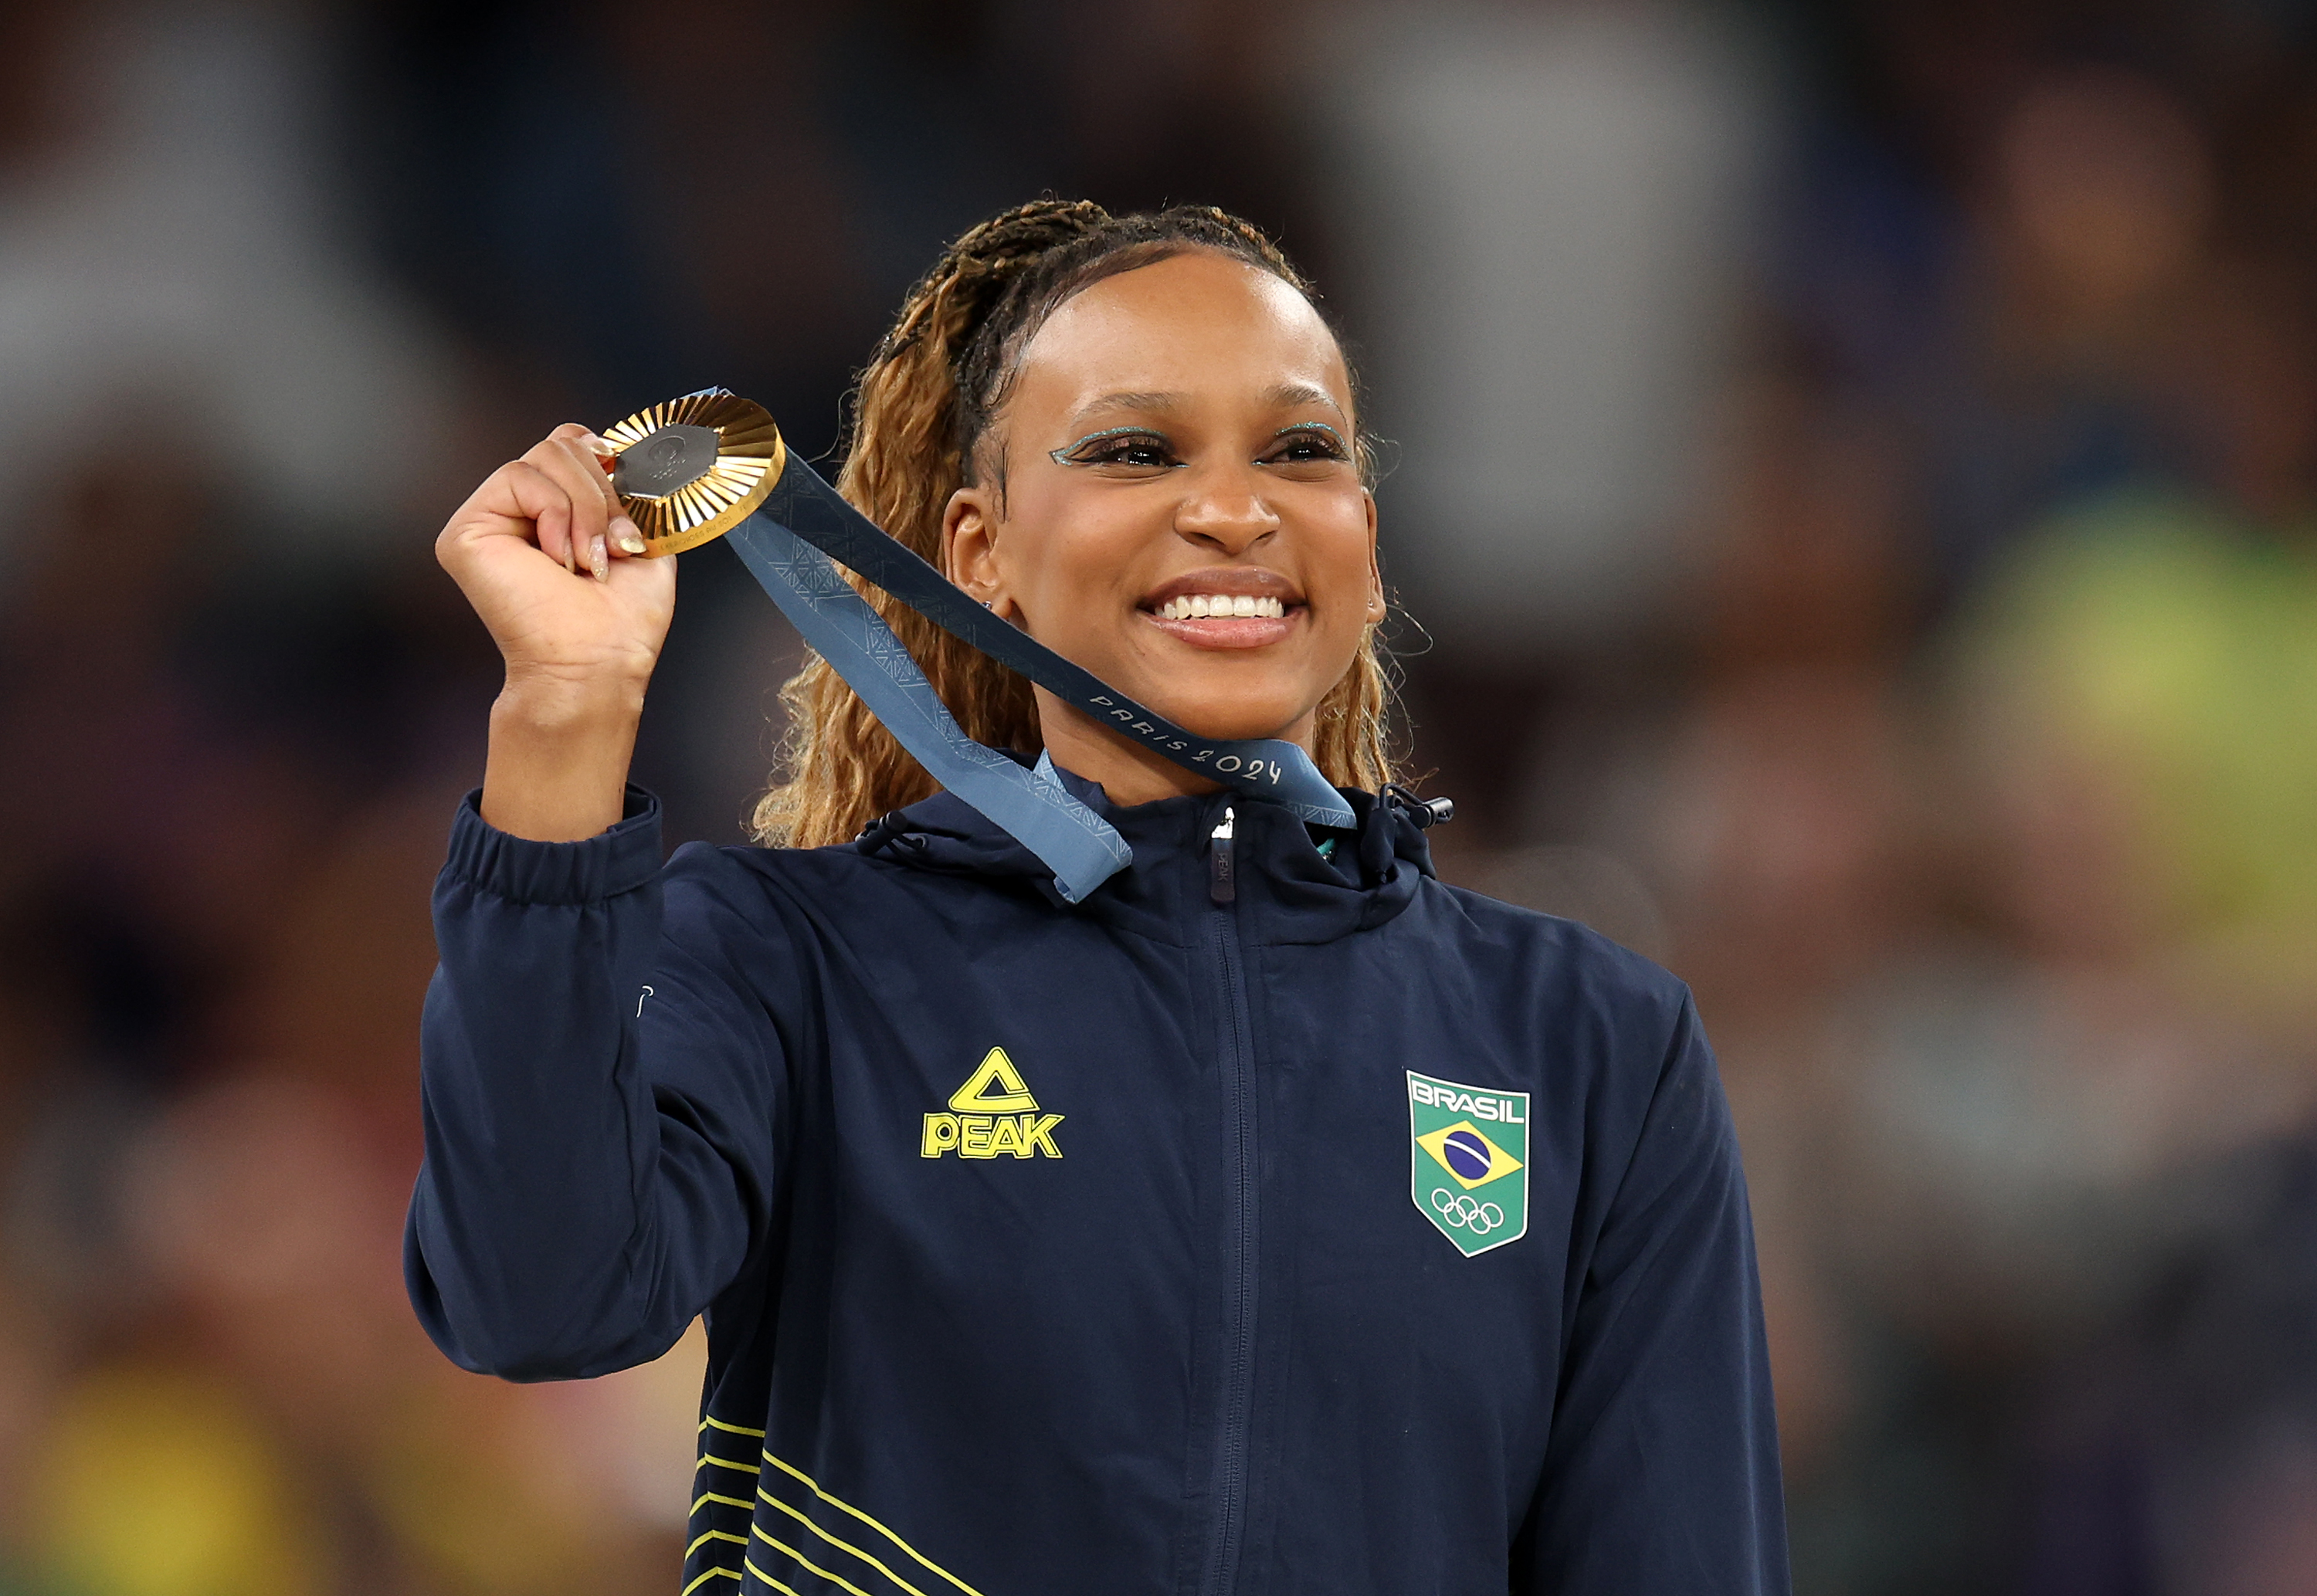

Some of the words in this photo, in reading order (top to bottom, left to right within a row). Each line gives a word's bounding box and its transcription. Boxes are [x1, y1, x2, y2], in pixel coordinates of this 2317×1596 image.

[1089, 696, 1188, 751] PARIS
[1191, 750, 1282, 785] 2024
[1218, 852, 1229, 882] PEAK
[1411, 1079, 1525, 1124] BRASIL
[921, 1113, 1066, 1159] PEAK
